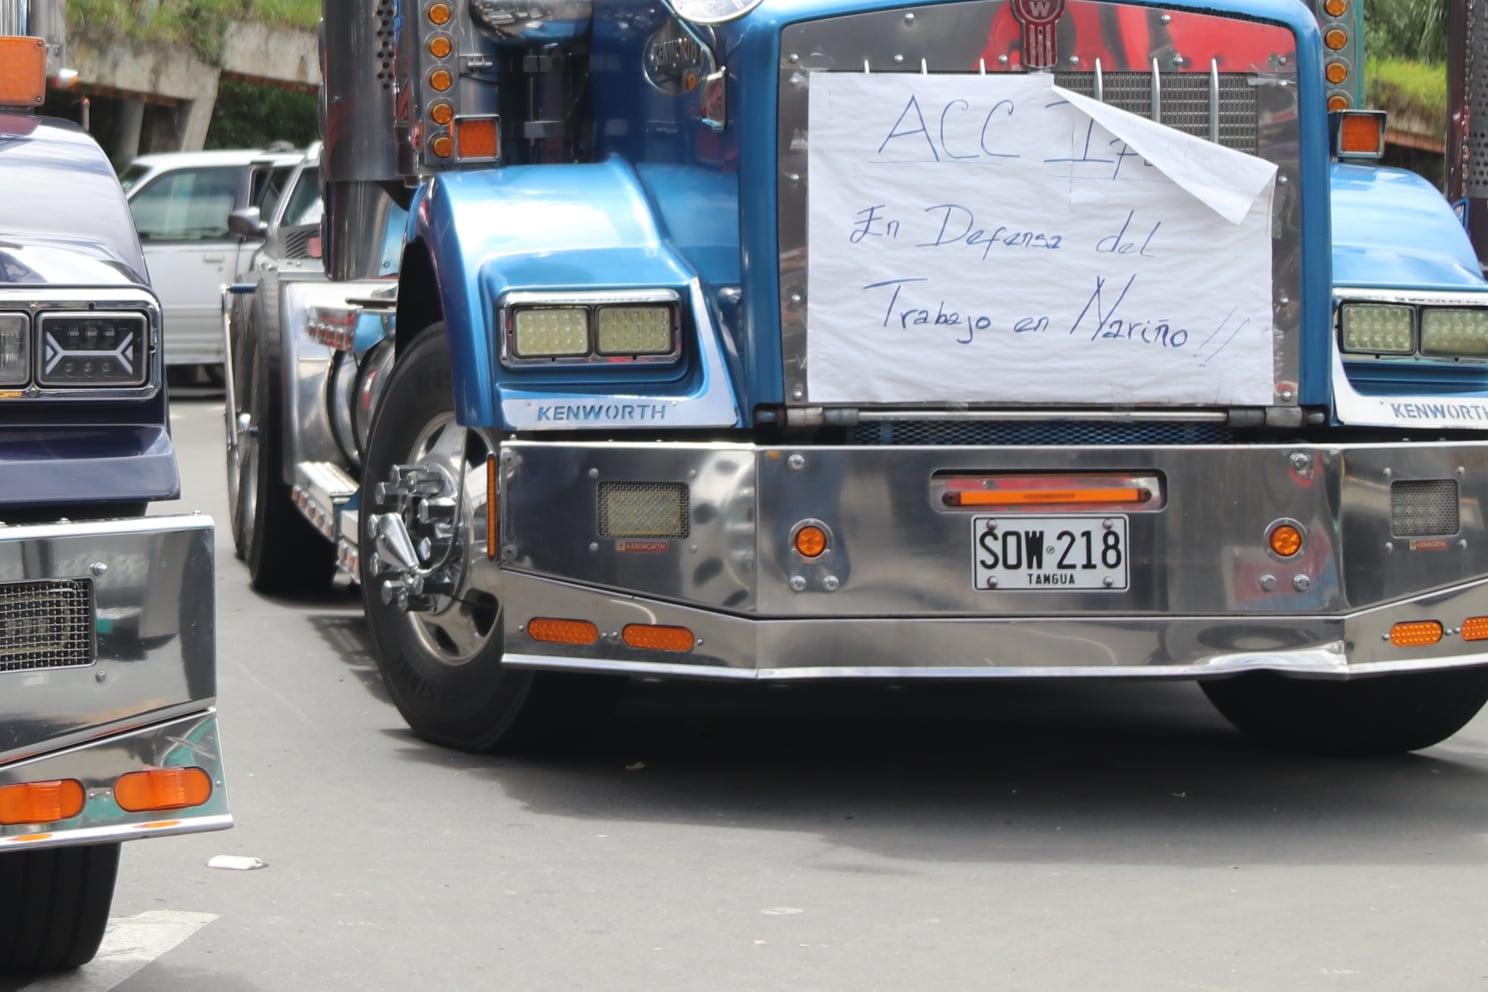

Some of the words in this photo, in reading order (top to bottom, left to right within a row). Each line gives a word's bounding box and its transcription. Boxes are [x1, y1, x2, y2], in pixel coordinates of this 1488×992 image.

[878, 95, 1020, 162] ACC
[850, 204, 901, 244] En
[916, 204, 1063, 260] Defensa
[1097, 210, 1162, 258] del
[863, 277, 992, 344] Trabajo
[1013, 314, 1050, 334] en
[537, 404, 667, 421] KENWORTH
[1056, 530, 1122, 570] 218
[1027, 573, 1076, 585] TANGUA
